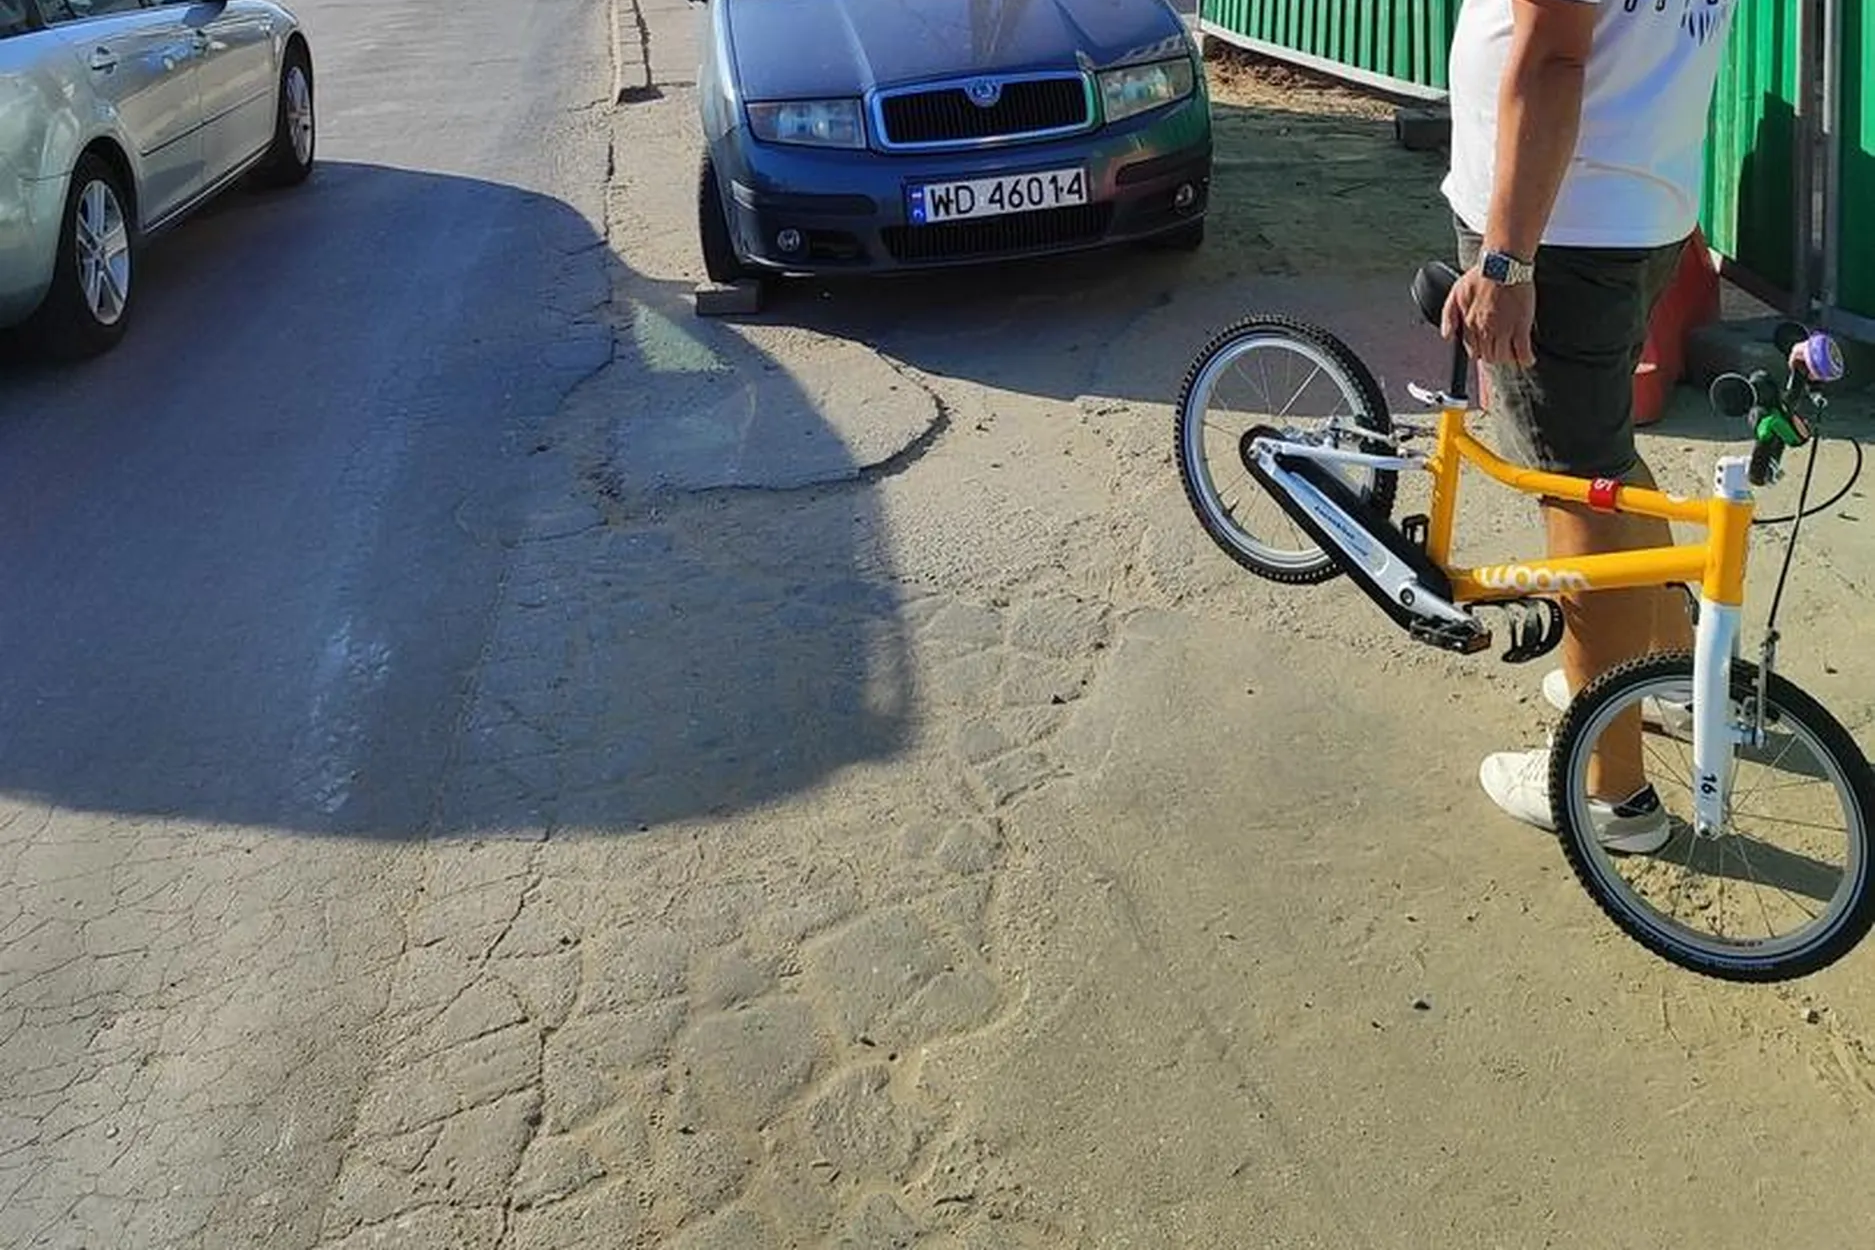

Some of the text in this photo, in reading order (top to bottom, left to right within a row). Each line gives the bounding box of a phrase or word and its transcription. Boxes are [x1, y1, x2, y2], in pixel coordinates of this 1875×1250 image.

[930, 172, 1084, 217] WD 46014
[1472, 564, 1592, 591] woom
[1701, 773, 1718, 795] 16
